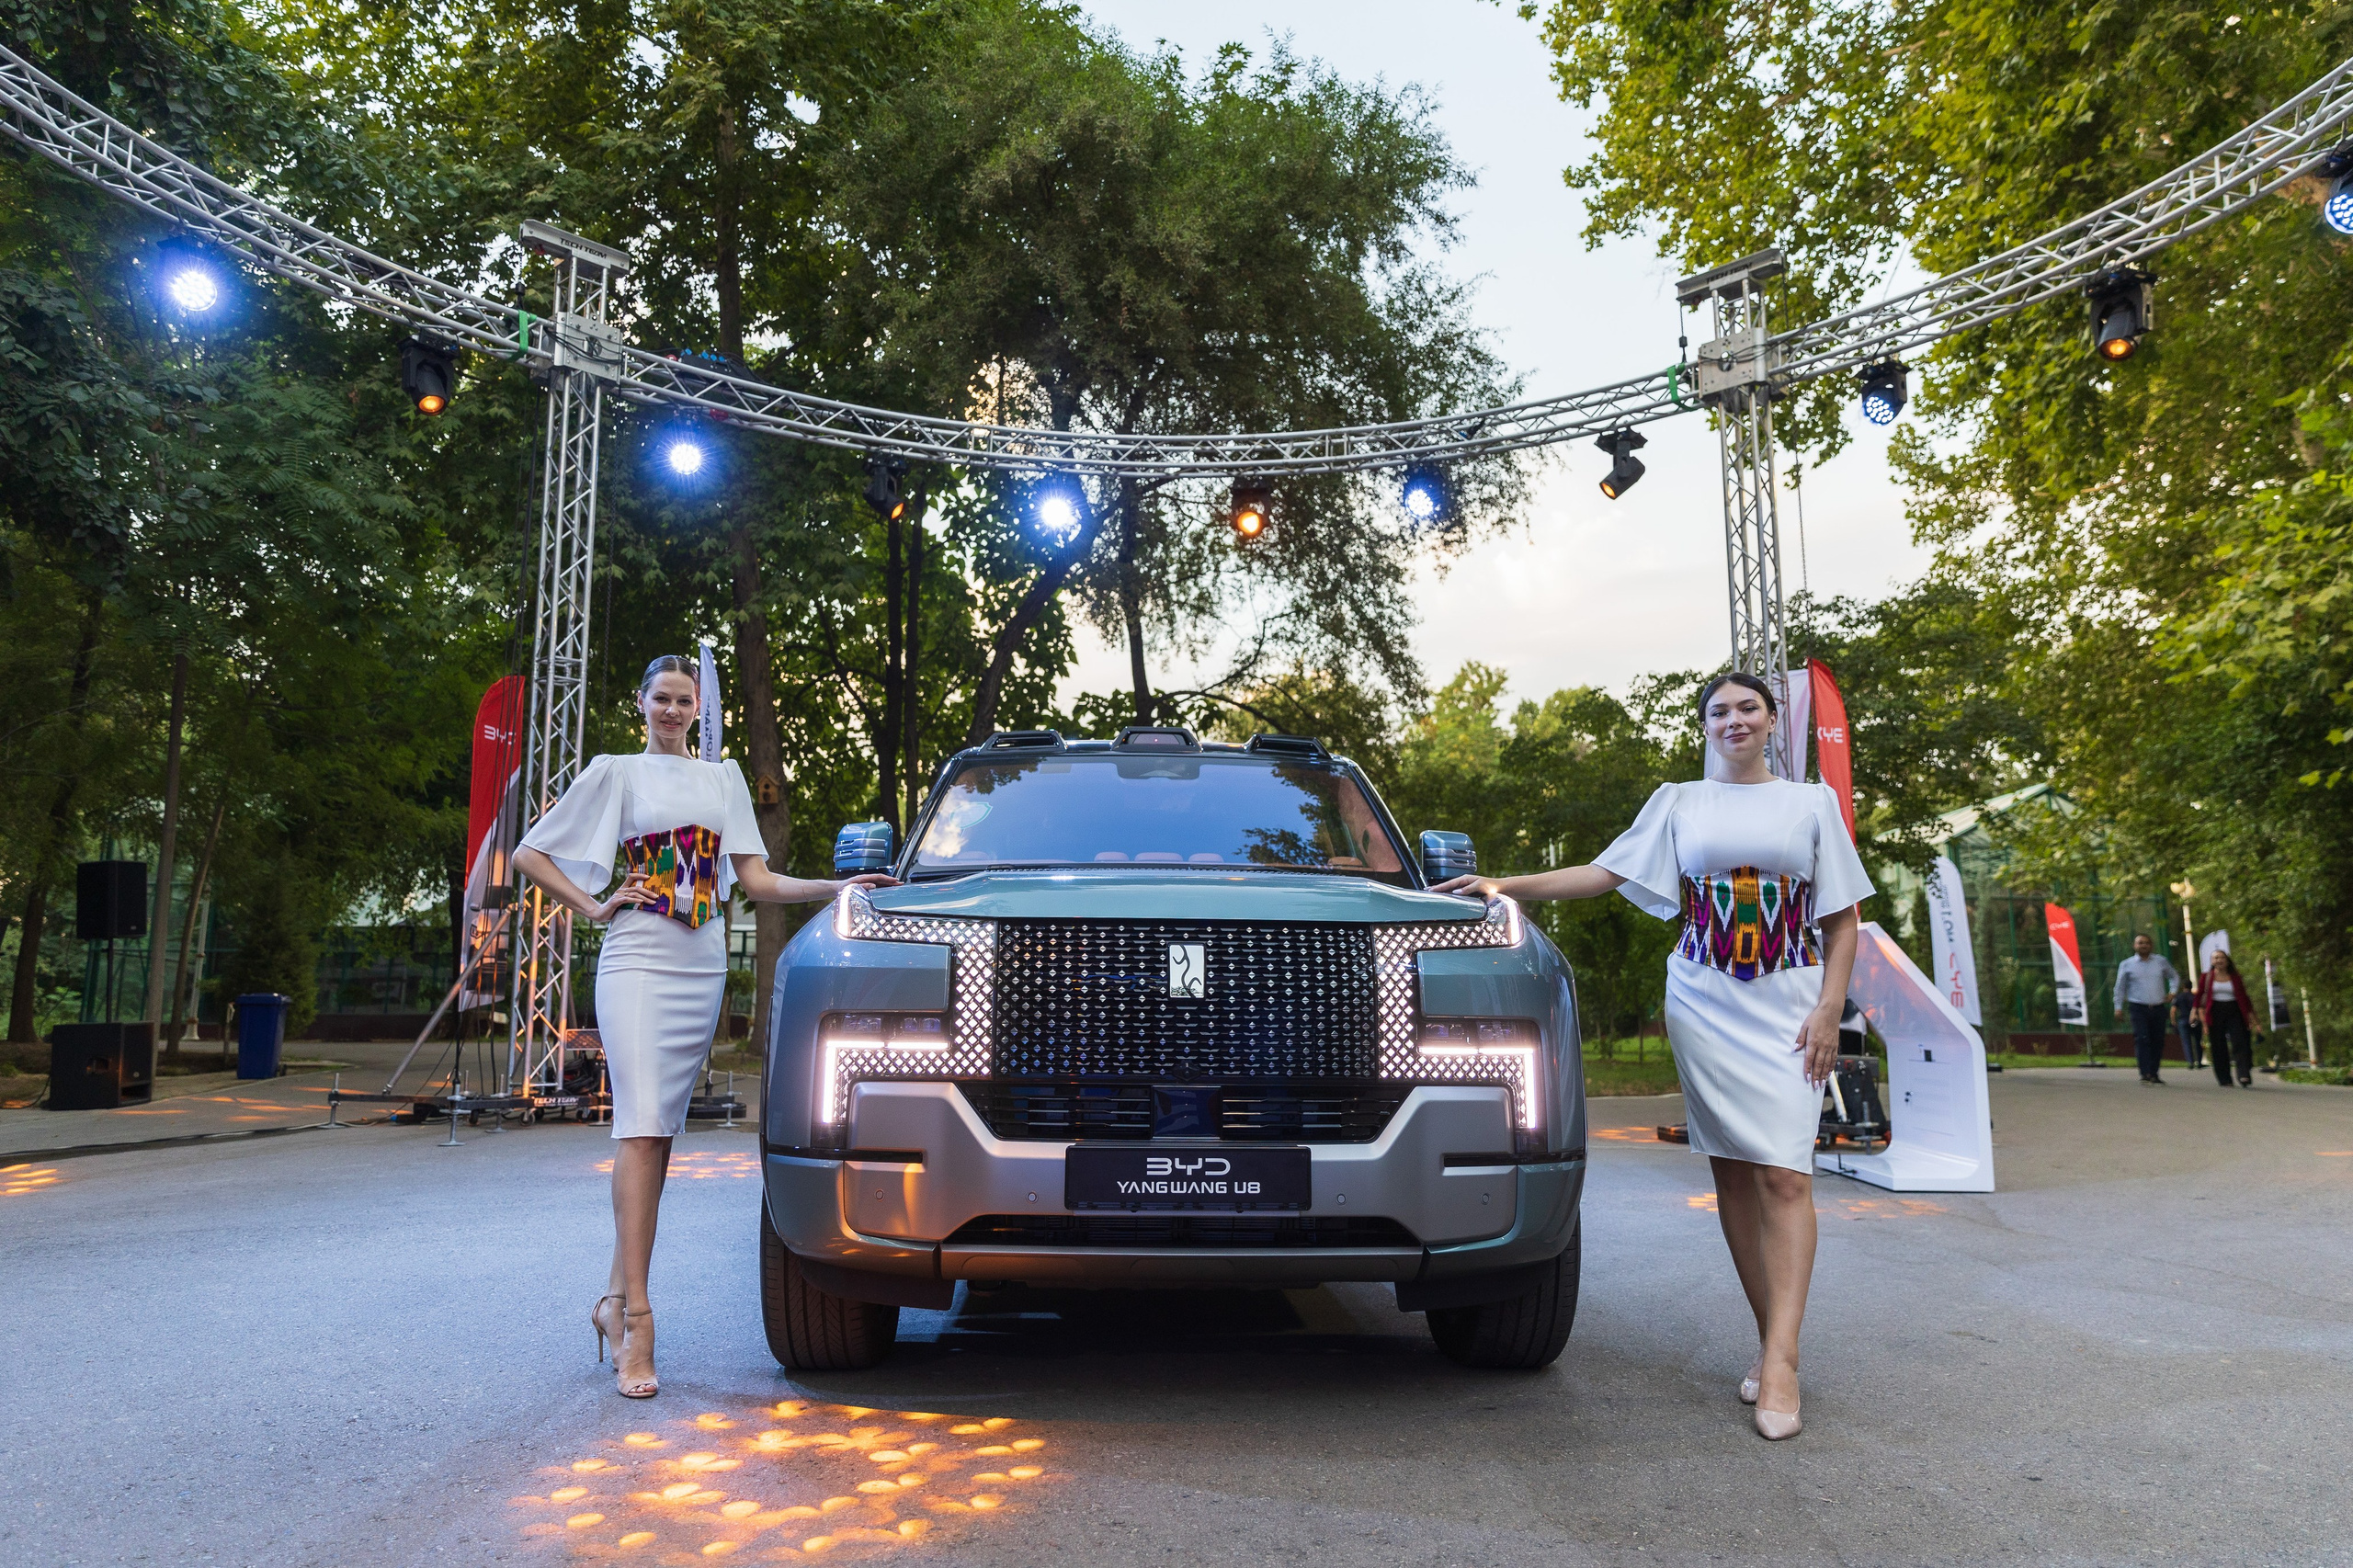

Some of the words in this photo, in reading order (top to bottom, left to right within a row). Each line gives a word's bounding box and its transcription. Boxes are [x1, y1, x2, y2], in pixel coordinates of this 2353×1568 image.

[1146, 1157, 1232, 1176] BYD
[1117, 1181, 1228, 1194] YANGWANG
[1233, 1181, 1261, 1194] U8
